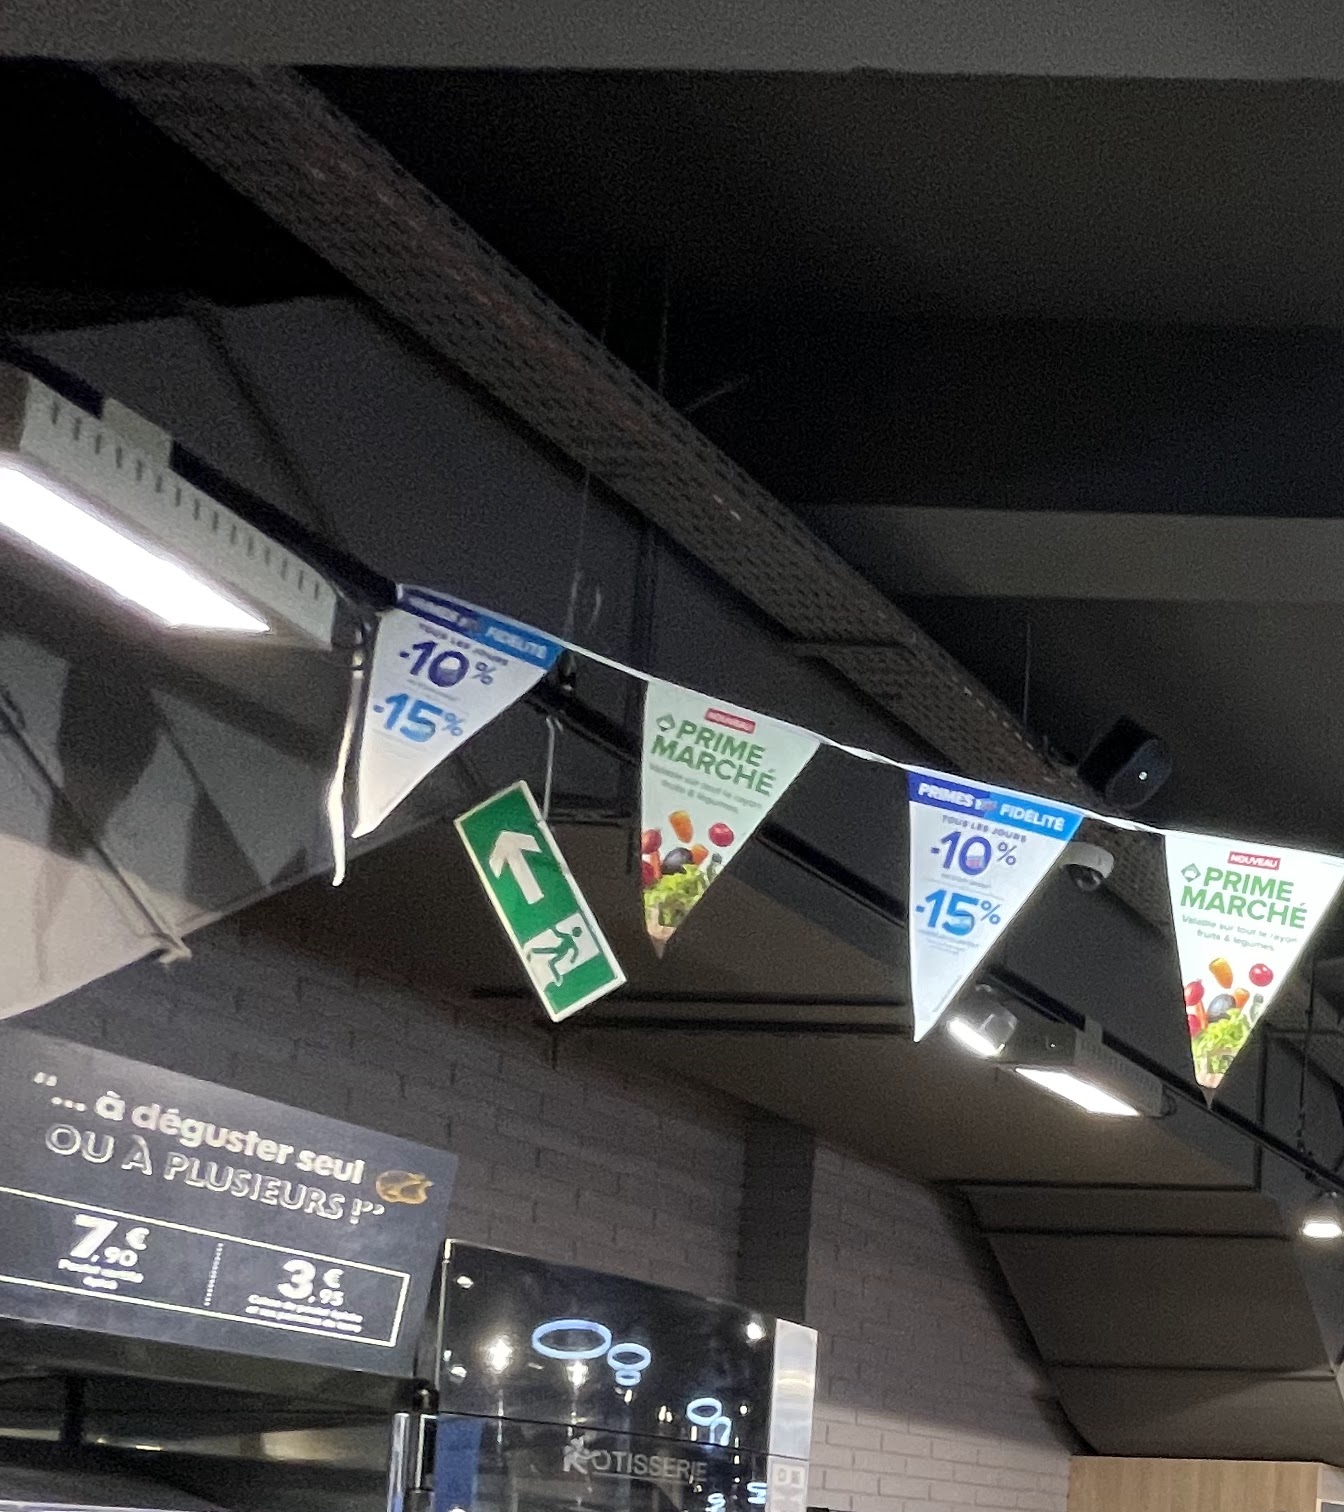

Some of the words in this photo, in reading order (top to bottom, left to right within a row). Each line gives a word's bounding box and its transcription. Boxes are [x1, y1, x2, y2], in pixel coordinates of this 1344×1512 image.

[650, 734, 776, 797] MARCHÉ
[675, 719, 768, 768] PRIME
[918, 782, 975, 808] PRIMES
[999, 803, 1066, 832] FIDÉLITÉ
[930, 830, 1018, 876] -10%
[1229, 852, 1279, 870] NOUVEAU
[1180, 885, 1308, 929] MARCHÉ
[1203, 866, 1294, 902] PRIME
[915, 888, 1002, 936] -15%
[131, 1103, 294, 1165] déguster
[295, 1150, 366, 1184] seul
[45, 1123, 115, 1164] OU
[163, 1151, 346, 1220] PLUSIEURS
